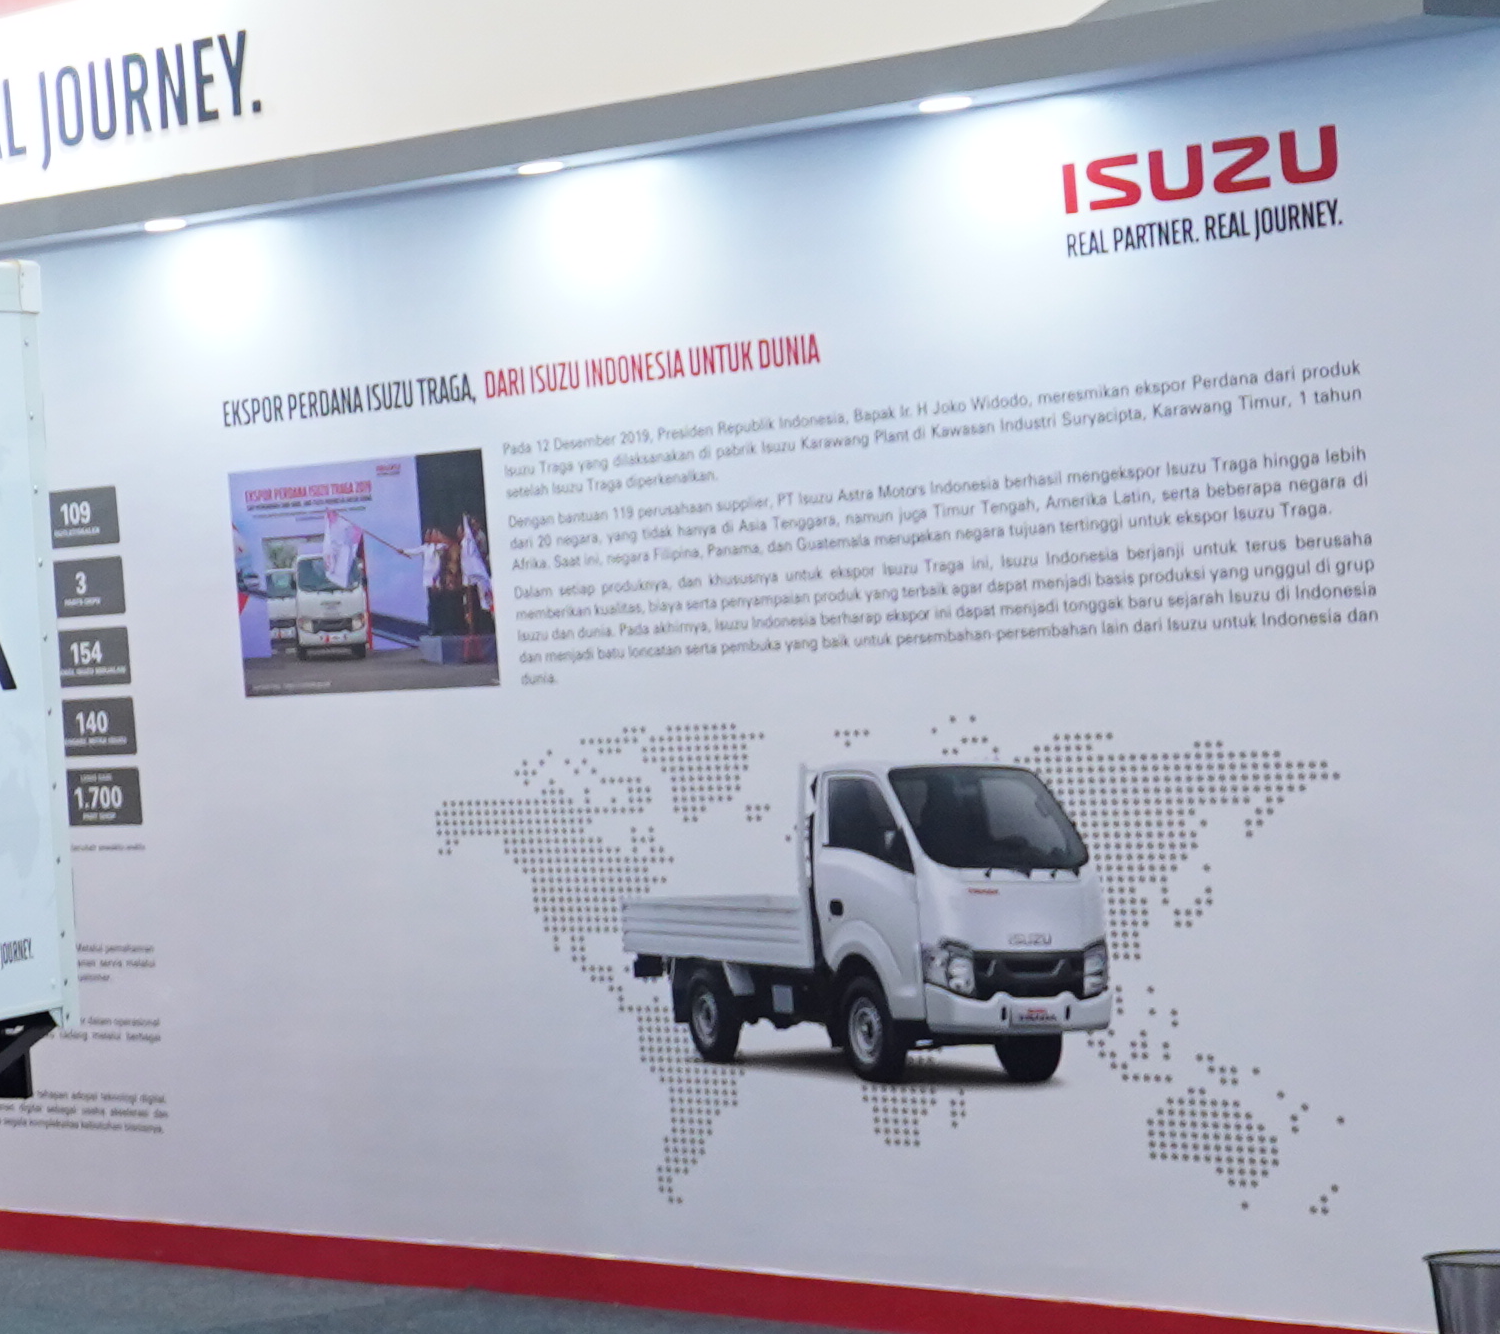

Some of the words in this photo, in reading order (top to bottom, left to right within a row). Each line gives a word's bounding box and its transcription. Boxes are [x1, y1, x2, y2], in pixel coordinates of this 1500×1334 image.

[37, 29, 263, 171] JOURNEY.
[1062, 123, 1339, 214] ISUZU
[1066, 228, 1109, 258] REAL
[1112, 217, 1200, 253] PARTNER.
[1204, 211, 1251, 242] REAL
[1254, 197, 1344, 243] JOURNEY.
[222, 394, 285, 427] EKSPOR
[287, 385, 363, 421] PERDANA
[366, 379, 414, 412] ISUZU
[415, 373, 477, 407] TRAGA,
[484, 366, 526, 400] DARI
[530, 359, 580, 395] ISUZU
[585, 347, 685, 388] INDONESIA
[688, 339, 753, 377] UNTUK
[757, 332, 821, 369] DUNIA
[916, 403, 928, 418] H
[932, 400, 967, 416] Joko
[1037, 385, 1130, 407] meresmikan
[1134, 381, 1186, 399] ekspor
[1192, 374, 1259, 392] Perdana
[1264, 367, 1296, 385] dari
[1301, 361, 1360, 385] produk
[912, 424, 926, 439] di
[930, 421, 995, 437] Kawasan
[999, 412, 1057, 432] Industri
[1152, 401, 1232, 418] Karawang
[1300, 390, 1306, 406] 1
[1313, 387, 1362, 405] tahun
[1004, 471, 1062, 490] berhasil
[1066, 466, 1161, 486] mengekspor
[1166, 462, 1207, 477] Isuzu
[1214, 458, 1258, 475] Traga
[1262, 453, 1320, 471] hingga
[1325, 447, 1366, 465] lebih
[1045, 491, 1108, 509] Amerika
[1161, 486, 1200, 501] serta
[1206, 481, 1282, 498] beberapa
[1288, 477, 1346, 494] negara
[1352, 472, 1368, 488] di
[59, 500, 92, 527] 109
[954, 527, 1005, 543] negara
[1008, 521, 1056, 540] tujuan
[1059, 515, 1124, 534] tertinggi
[1128, 511, 1172, 529] untuk
[1175, 510, 1228, 527] ekspor
[1233, 506, 1275, 522] Isuzu
[1000, 554, 1039, 569] Isuzu
[1045, 548, 1119, 566] Indonesia
[1126, 543, 1185, 564] berjanji
[1192, 540, 1238, 557] untuk
[1245, 540, 1287, 554] terus
[1294, 531, 1372, 551] berusaha
[74, 571, 88, 595] 3
[986, 579, 1028, 597] dapat
[1031, 574, 1092, 594] menjadi
[1095, 572, 1135, 588] basis
[1138, 567, 1206, 589] produksi
[1210, 568, 1250, 585] yang
[1253, 561, 1311, 581] unggul
[1315, 559, 1331, 575] di
[1335, 561, 1375, 578] grup
[999, 599, 1059, 619] menjadi
[1063, 596, 1124, 616] tonggak
[1127, 595, 1163, 610] baru
[1167, 590, 1224, 611] sejarah
[1228, 589, 1271, 605] Isuzu
[1275, 587, 1290, 602] di
[1295, 582, 1377, 601] Indonesia
[1101, 620, 1129, 636] lain
[1132, 618, 1163, 635] dari
[1166, 617, 1208, 633] Isuzu
[1212, 613, 1257, 631] untuk
[1261, 609, 1342, 628] Indonesia
[1346, 608, 1379, 623] dan
[69, 640, 103, 665] 154
[75, 709, 109, 736] 140
[73, 783, 123, 812] 1.700
[0, 937, 34, 970] JOURNEY.
